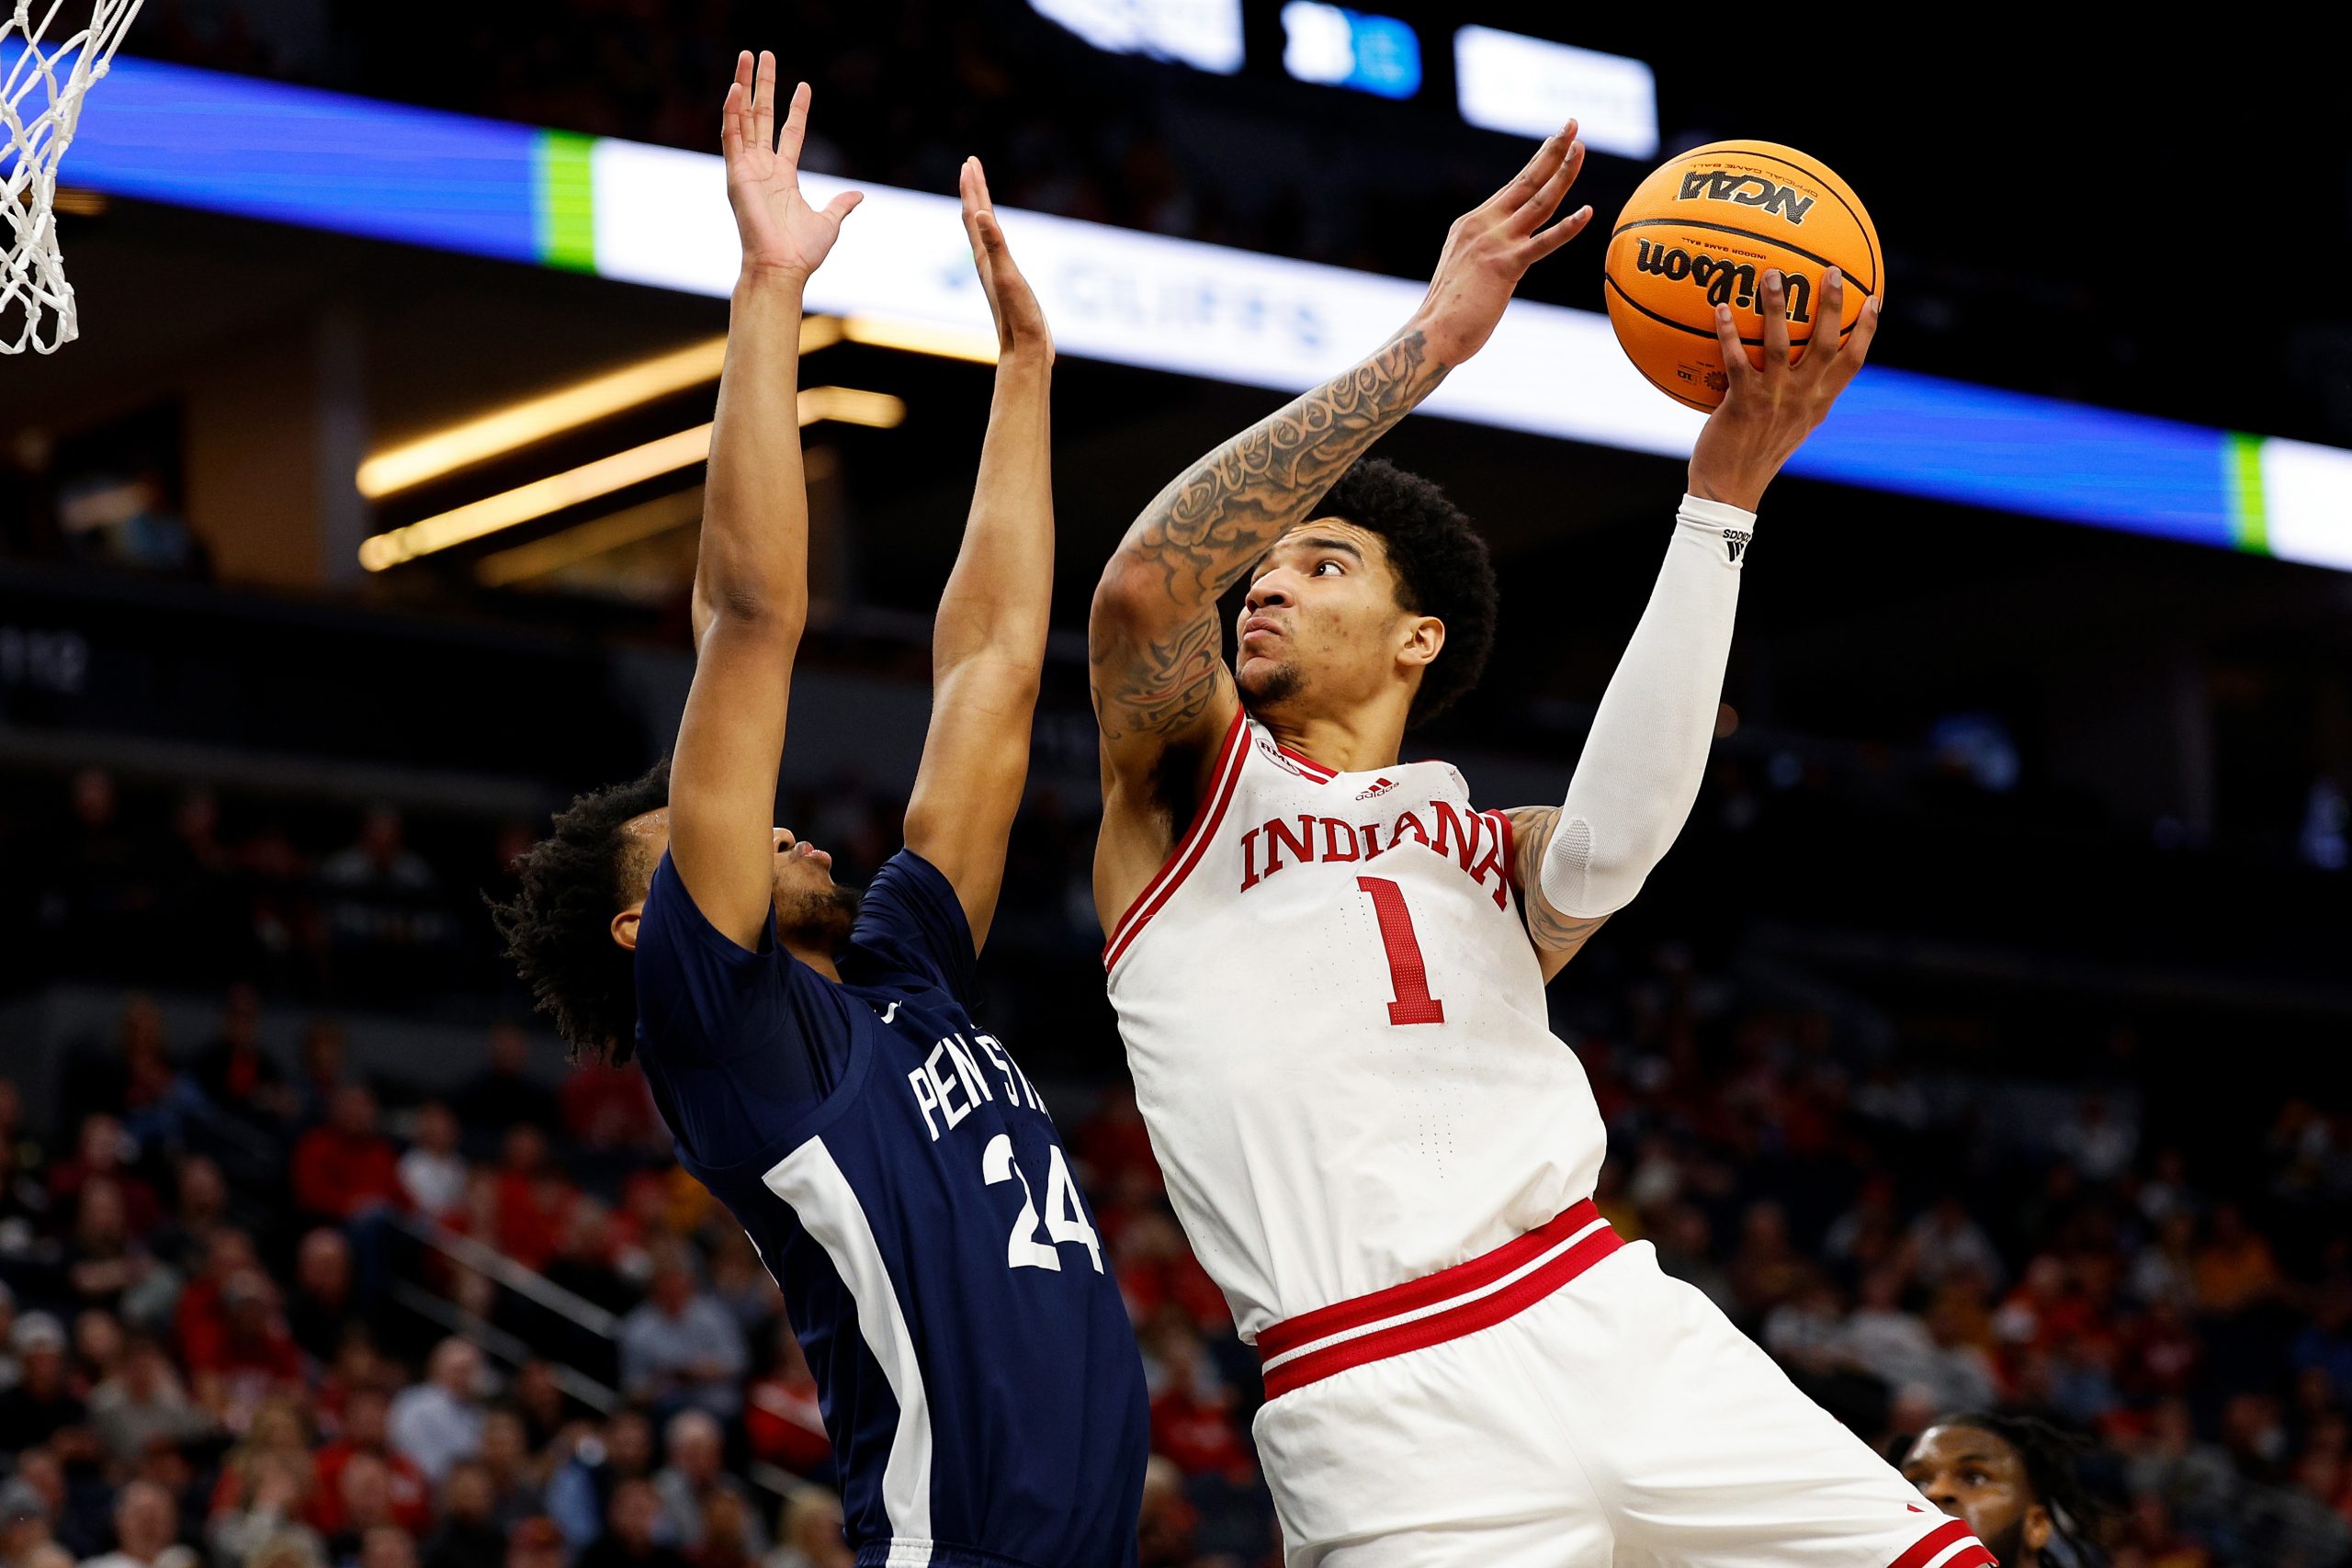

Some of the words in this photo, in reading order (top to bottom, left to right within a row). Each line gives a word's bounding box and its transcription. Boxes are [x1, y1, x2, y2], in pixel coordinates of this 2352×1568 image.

[1678, 171, 1815, 226] NCAA
[1681, 237, 1702, 246] BALL
[1704, 243, 1729, 252] GAME
[1732, 249, 1767, 260] INDOOR
[1636, 238, 1812, 323] Wilson
[1355, 782, 1399, 801] adidas
[1240, 800, 1509, 912] INDIANA
[1356, 875, 1445, 1026] 1
[982, 1134, 1104, 1275] 24
